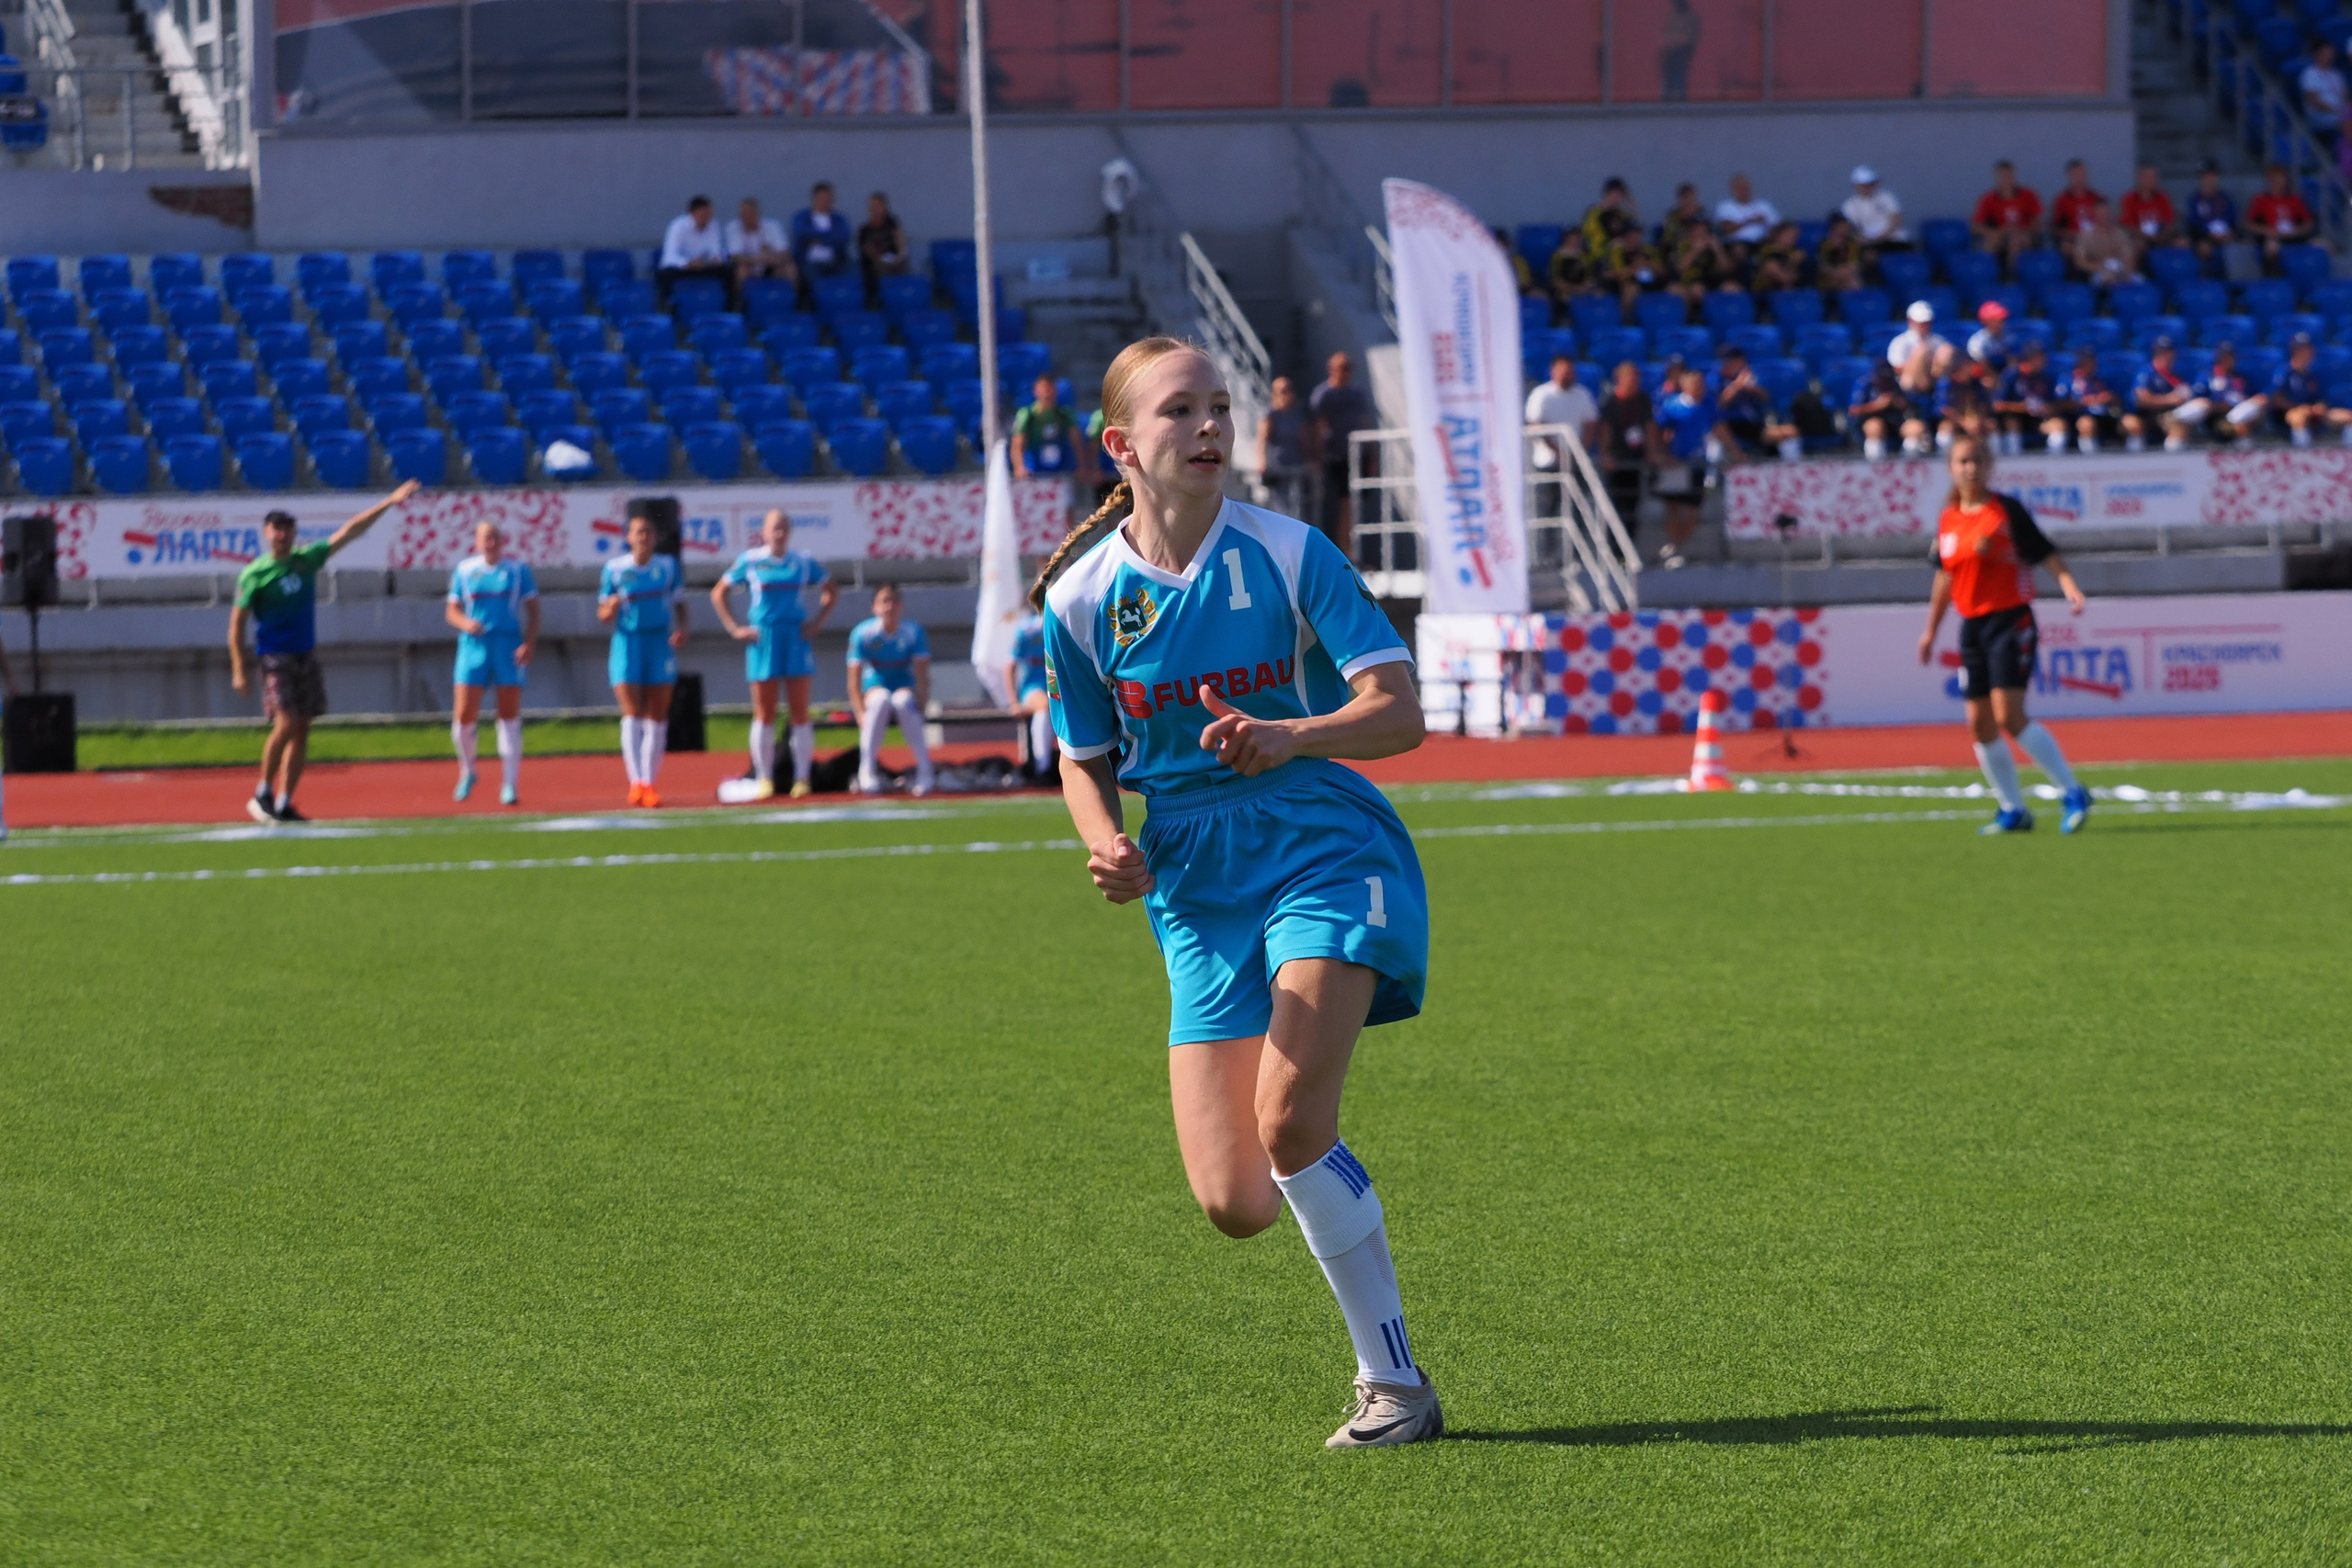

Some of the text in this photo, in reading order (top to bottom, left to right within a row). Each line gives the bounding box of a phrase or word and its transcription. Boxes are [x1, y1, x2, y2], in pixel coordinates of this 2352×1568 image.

[153, 528, 262, 563] ЛАПТА
[1223, 547, 1252, 611] 1
[1153, 654, 1295, 712] FURBAU
[1364, 876, 1387, 929] 1
